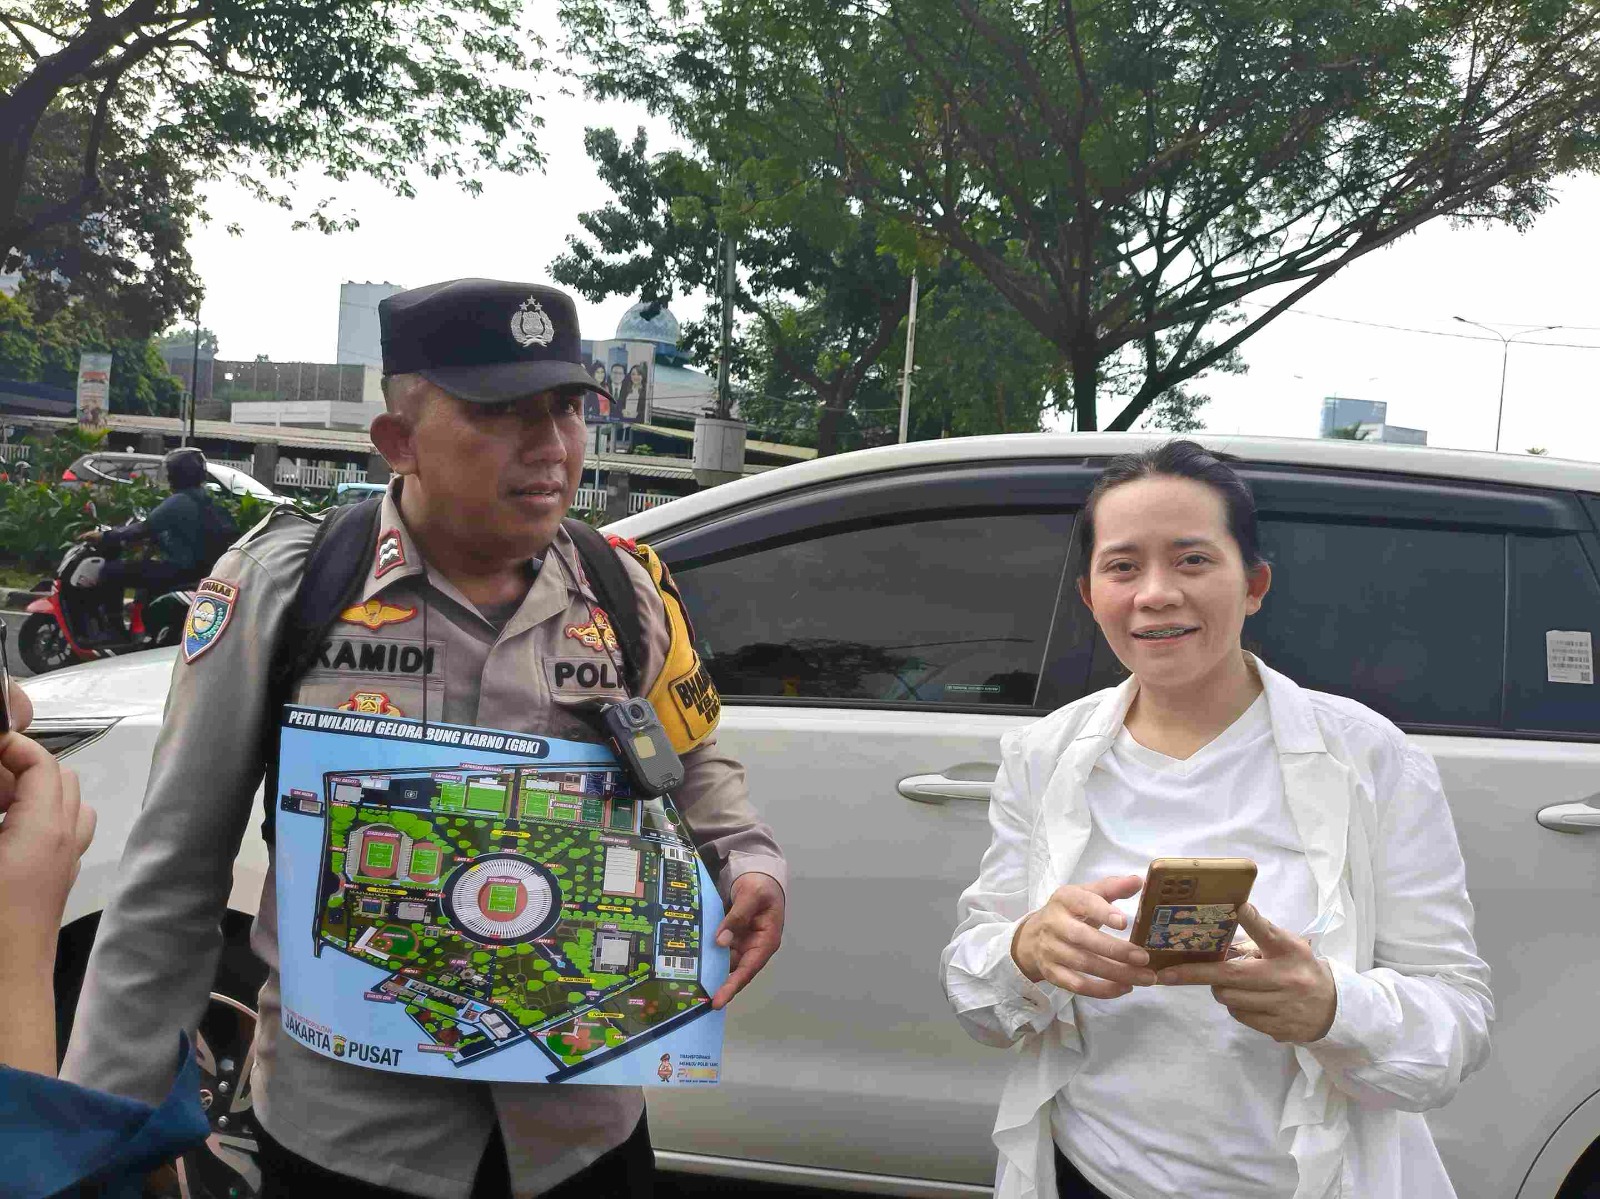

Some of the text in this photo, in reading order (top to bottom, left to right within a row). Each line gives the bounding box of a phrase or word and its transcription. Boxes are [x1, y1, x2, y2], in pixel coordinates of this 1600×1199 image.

[312, 640, 435, 674] KAMIDI
[288, 710, 316, 727] PETA
[318, 713, 373, 734] WILAYAH
[374, 720, 423, 740] GELORA
[425, 727, 460, 744] BUNG
[460, 731, 504, 750] KARNO
[285, 1014, 403, 1067] JAKARTA PUSAT
